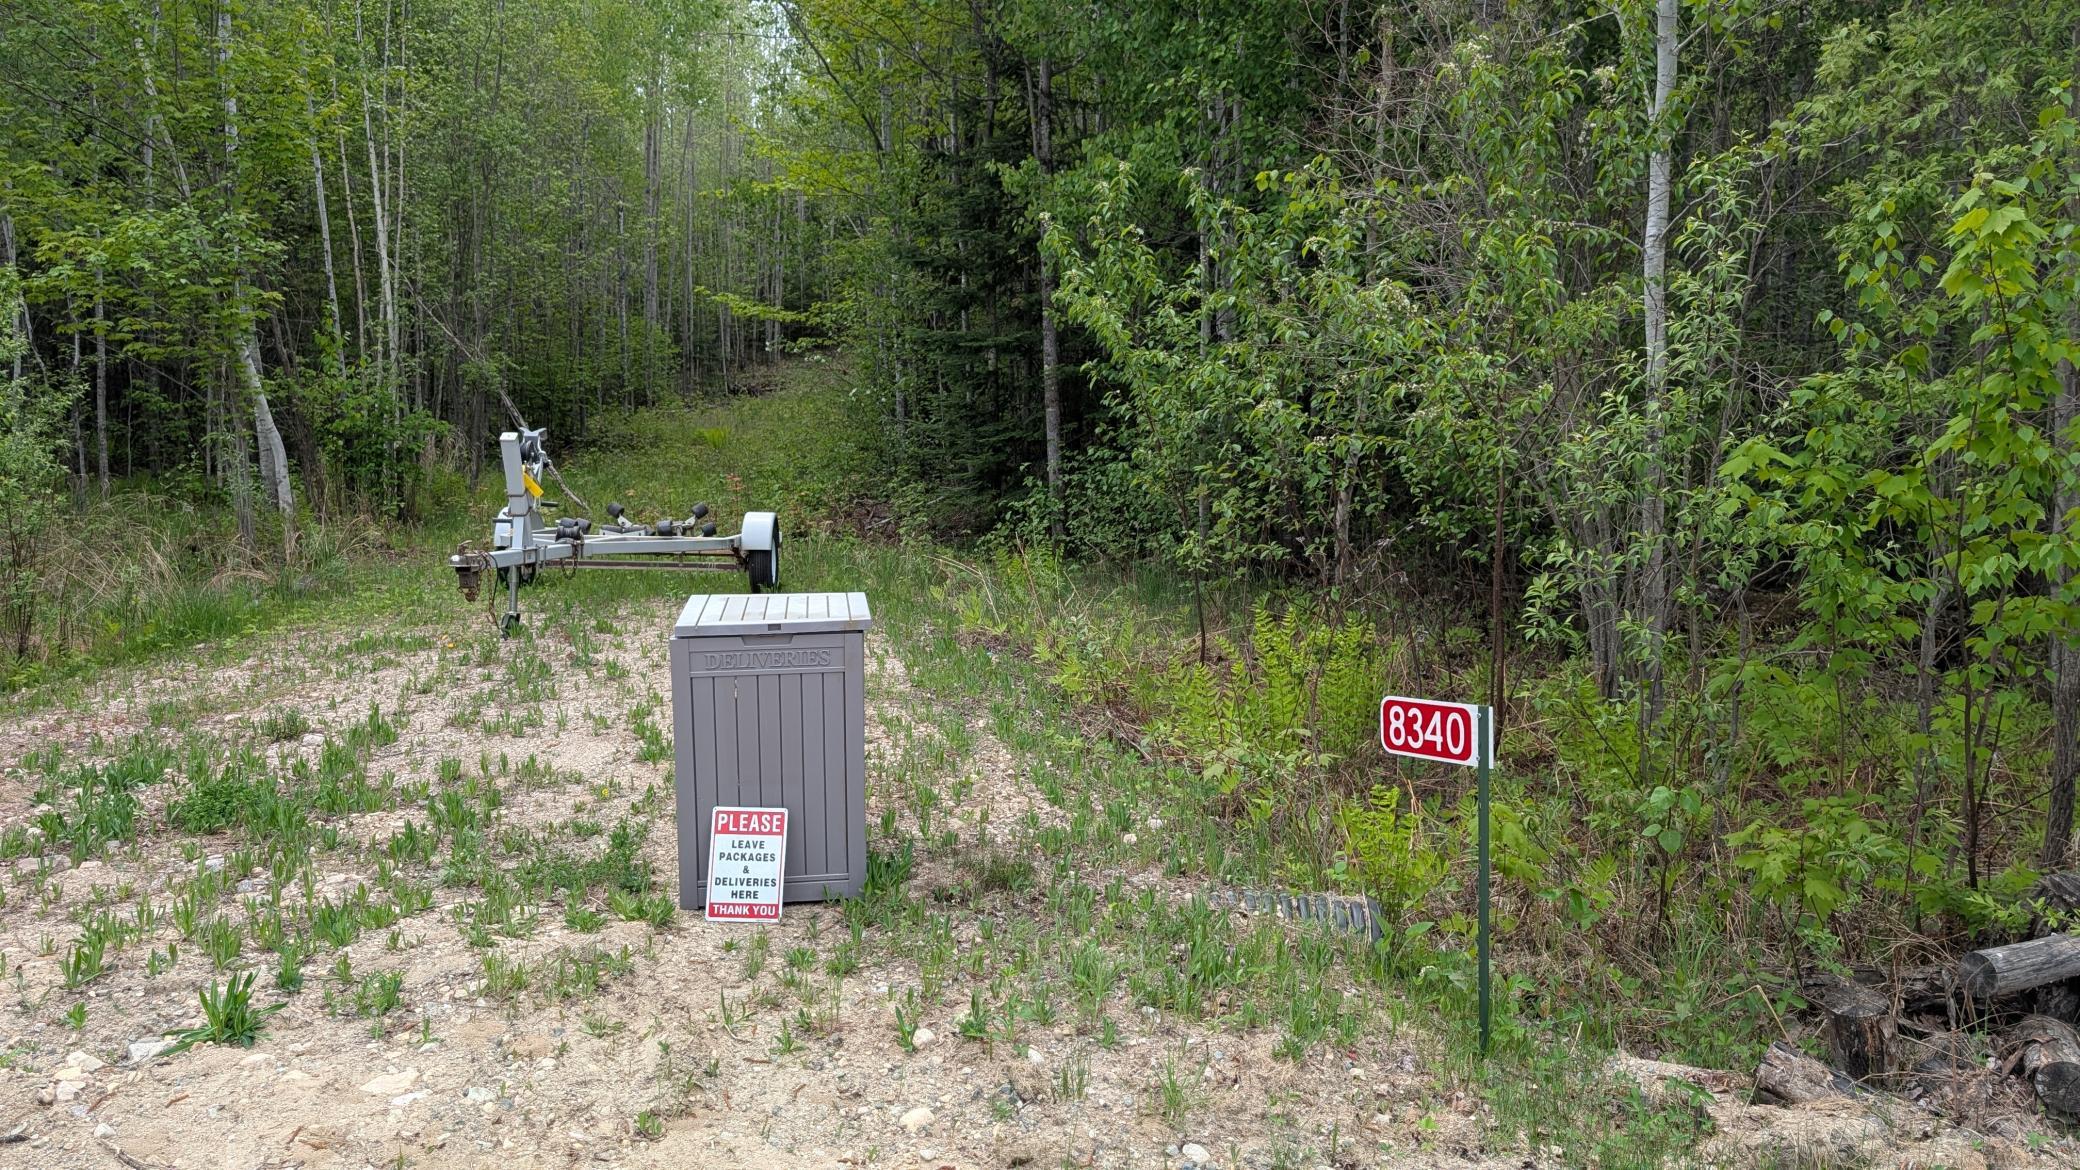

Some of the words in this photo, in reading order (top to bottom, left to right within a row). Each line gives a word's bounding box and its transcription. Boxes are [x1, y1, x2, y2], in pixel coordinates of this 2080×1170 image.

[704, 650, 831, 670] DELIVERIES
[1389, 705, 1465, 755] 8340
[717, 813, 782, 832] PLEASE
[731, 840, 765, 849] LEAVE
[719, 852, 776, 862] PACKAGES
[742, 865, 750, 874] &
[714, 877, 777, 887] DELIVERIES
[730, 890, 759, 899] HERE
[713, 904, 749, 915] THANK
[752, 906, 775, 916] YOU
